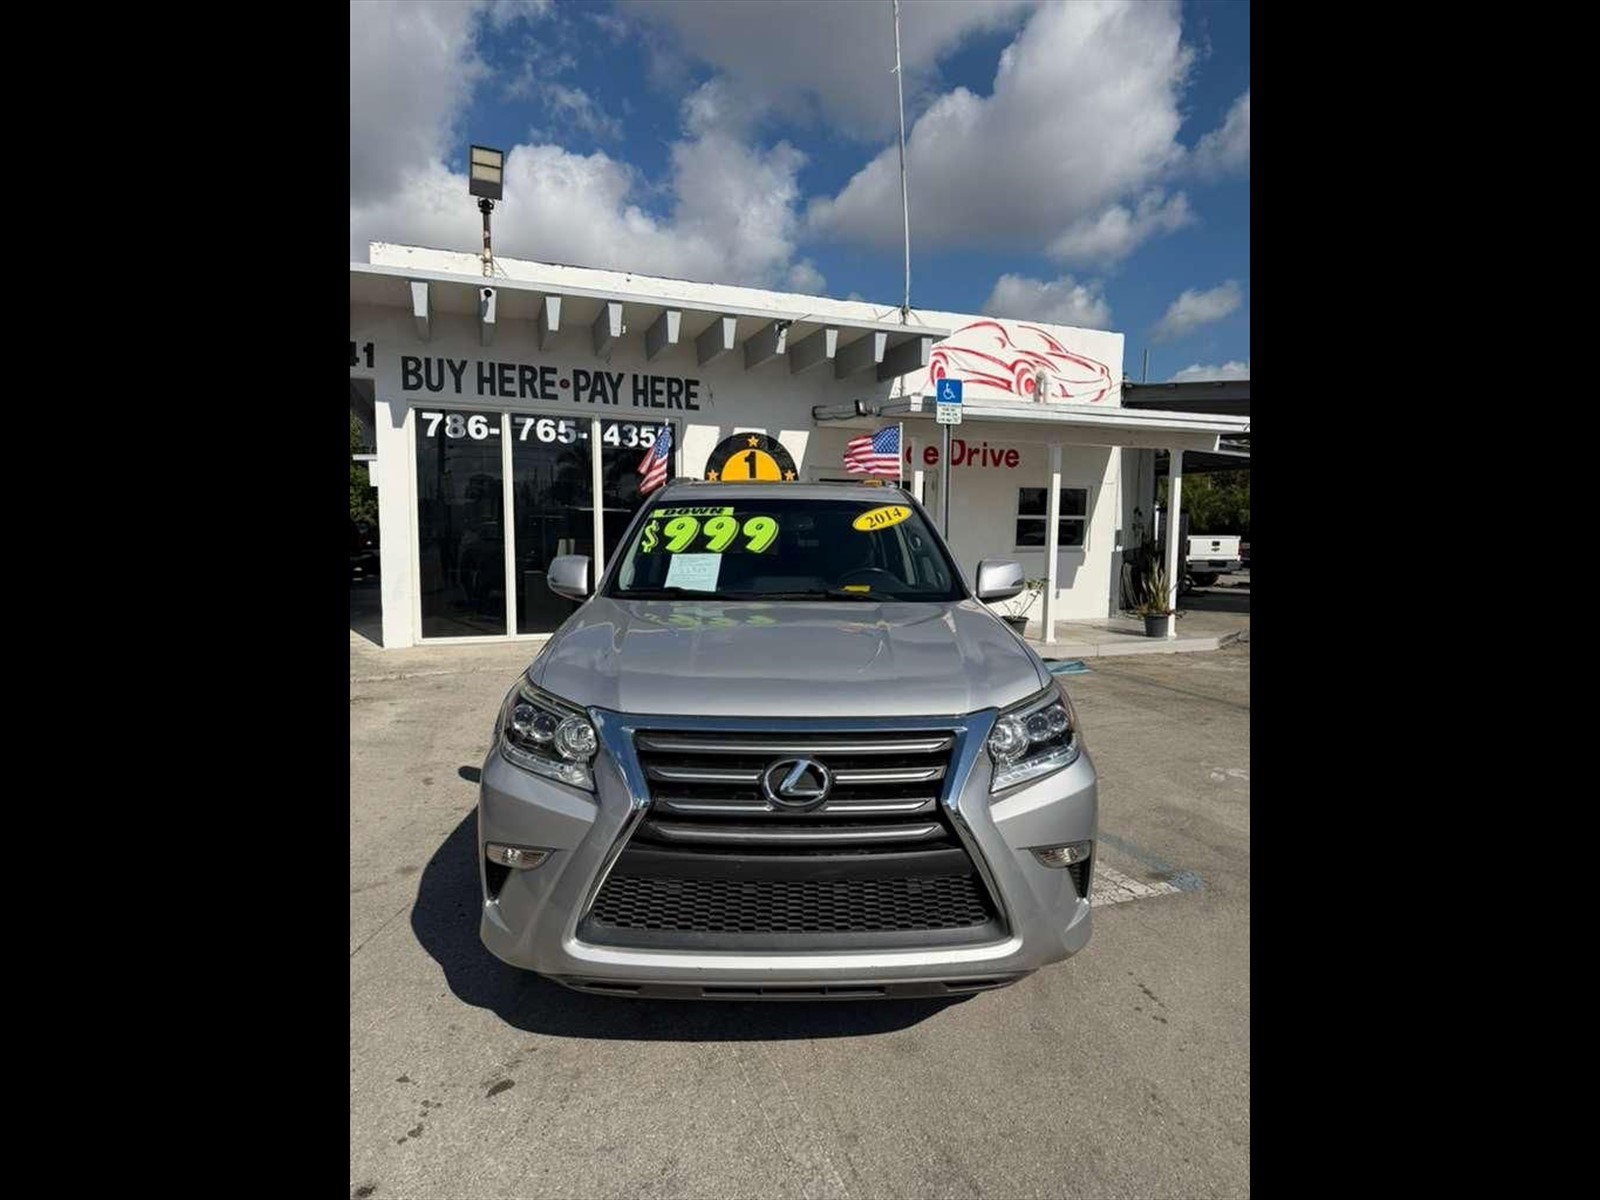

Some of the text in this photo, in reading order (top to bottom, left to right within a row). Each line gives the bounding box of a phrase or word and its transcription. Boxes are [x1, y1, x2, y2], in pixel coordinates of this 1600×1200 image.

[401, 356, 700, 411] BUY HERE PAY HERE
[744, 450, 757, 479] 1
[951, 439, 1020, 468] Drive
[865, 508, 902, 528] 2014
[641, 515, 779, 553] $999
